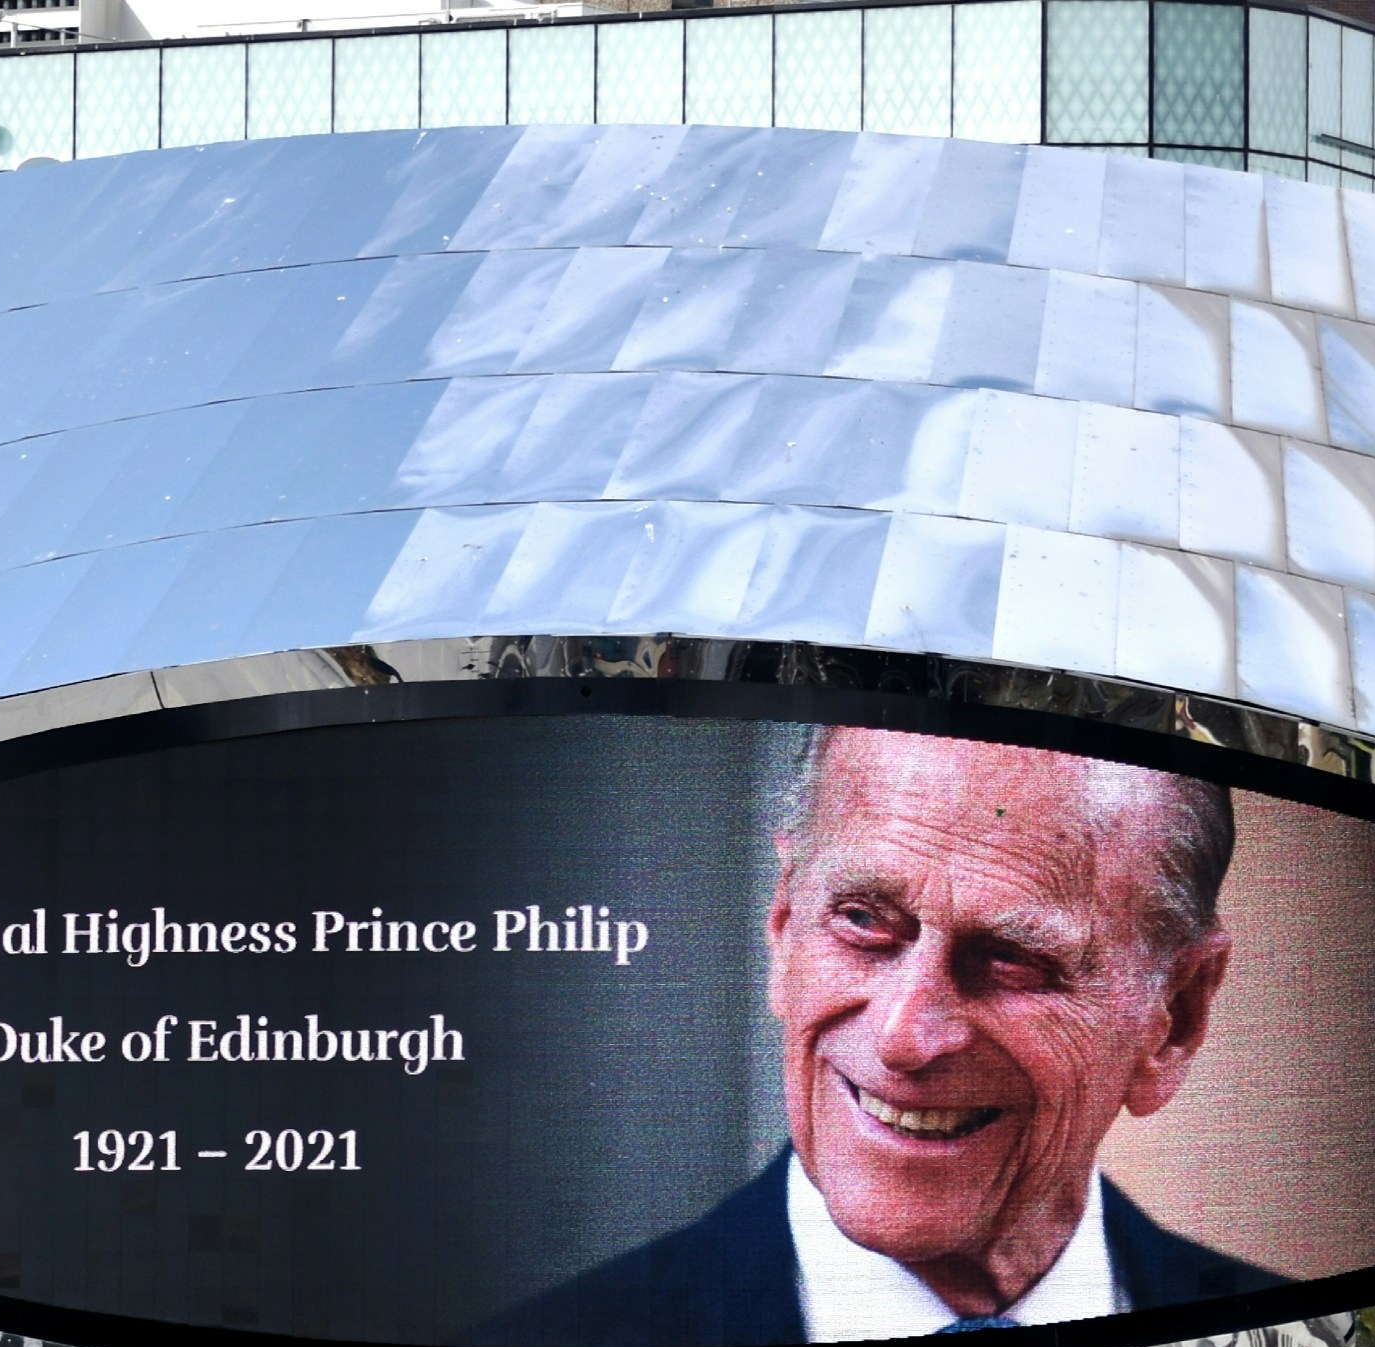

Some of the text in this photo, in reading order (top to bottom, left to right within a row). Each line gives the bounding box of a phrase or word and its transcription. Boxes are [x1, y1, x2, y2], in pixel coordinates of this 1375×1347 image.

[62, 907, 296, 967] Highness
[312, 907, 476, 952] Prince
[493, 906, 648, 965] Philip
[122, 1015, 178, 1061] of
[187, 1014, 465, 1074] Edinburgh
[74, 1130, 181, 1172] 1921
[245, 1129, 361, 1171] 2021
